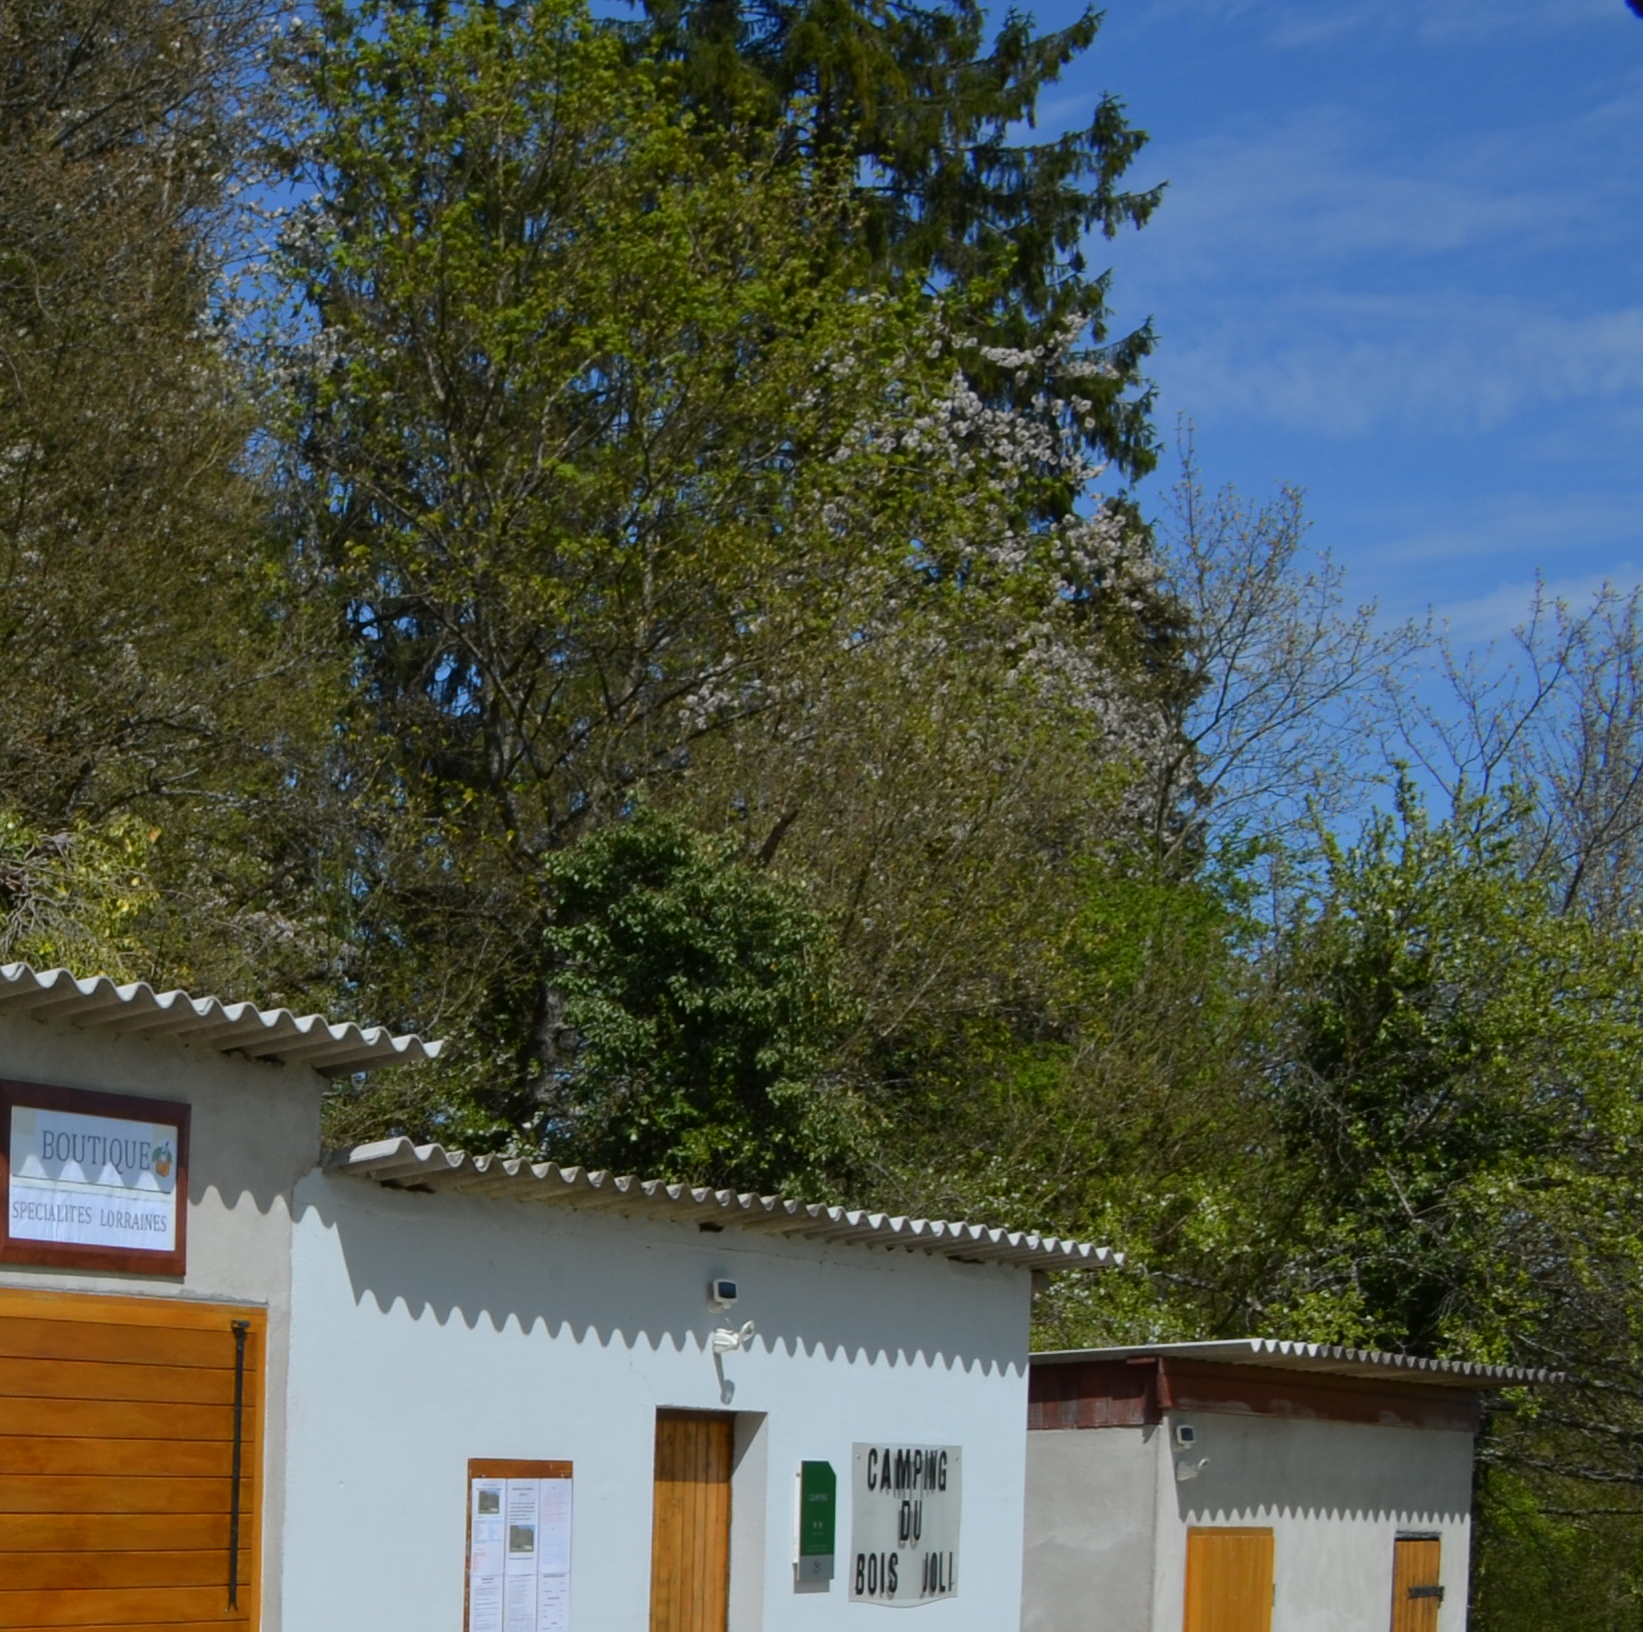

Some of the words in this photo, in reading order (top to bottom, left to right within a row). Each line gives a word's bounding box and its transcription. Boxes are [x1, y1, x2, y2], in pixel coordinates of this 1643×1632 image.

[42, 1130, 151, 1174] BOUTIQUE
[12, 1201, 92, 1225] SPECIALITES
[100, 1209, 167, 1232] LORRAINES
[867, 1448, 947, 1491] CAMPING
[900, 1500, 923, 1541] DU
[855, 1552, 899, 1595] BOIS
[922, 1552, 953, 1593] JOLI
